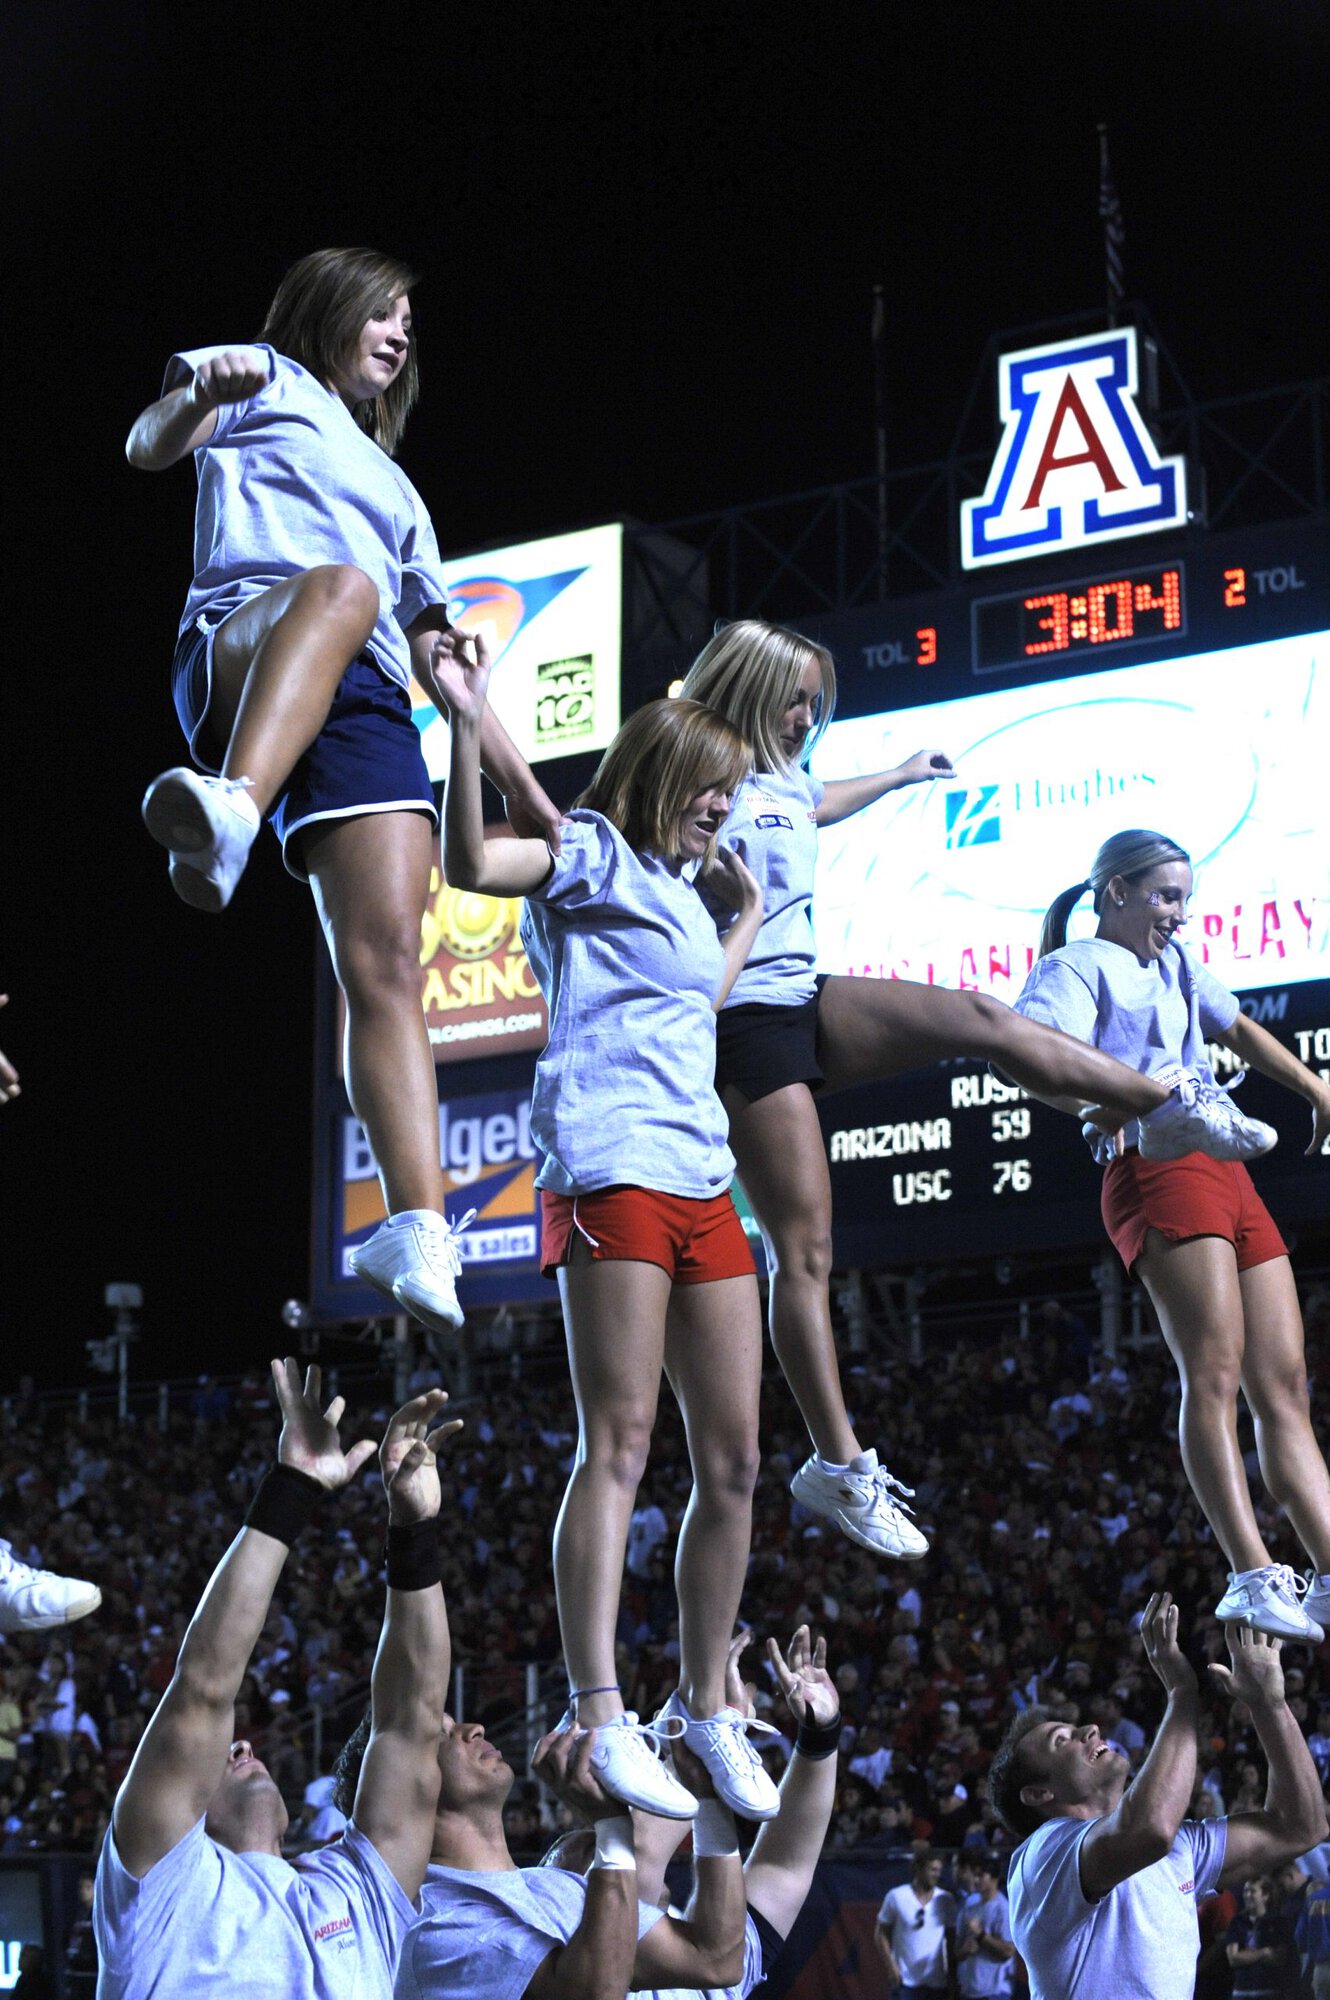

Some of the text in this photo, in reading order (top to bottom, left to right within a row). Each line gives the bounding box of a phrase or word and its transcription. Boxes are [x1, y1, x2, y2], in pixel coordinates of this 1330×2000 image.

[1025, 571, 1181, 655] 3:04
[1224, 566, 1305, 606] 2 TOL
[862, 628, 937, 670] TOL 3
[1202, 898, 1316, 964] PLAY
[421, 955, 542, 1013] ASINO
[344, 1101, 537, 1185] Bget
[830, 1107, 1031, 1162] ARIZONA 59
[892, 1158, 1032, 1206] USC 76
[480, 1228, 530, 1255] sales
